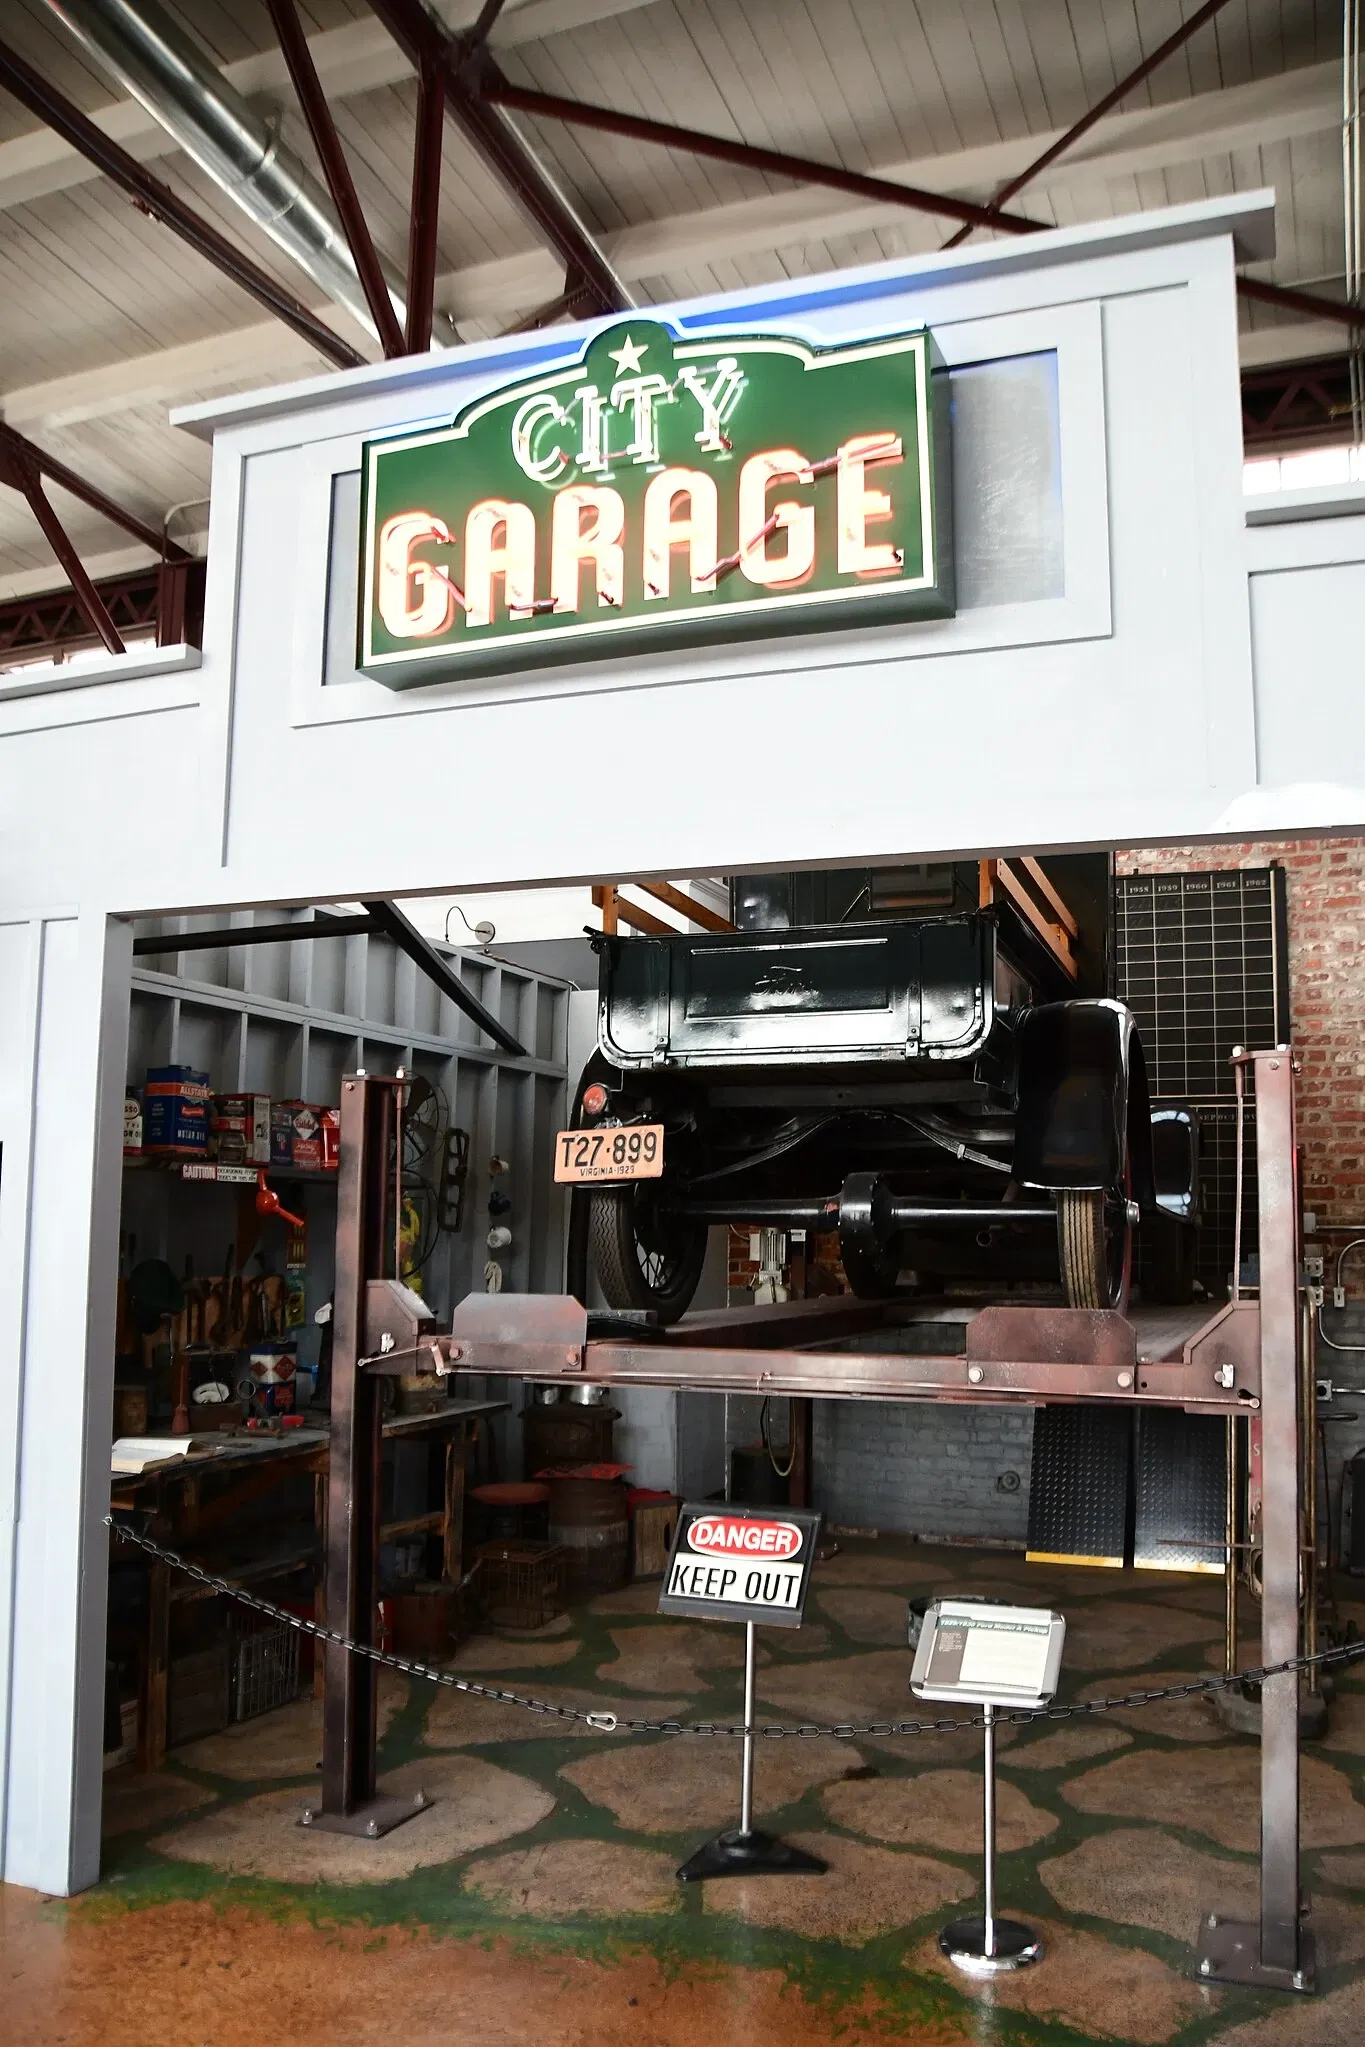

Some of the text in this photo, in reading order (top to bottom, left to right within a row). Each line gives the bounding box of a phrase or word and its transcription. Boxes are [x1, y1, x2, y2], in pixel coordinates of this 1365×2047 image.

[511, 357, 748, 488] CITY
[378, 432, 904, 638] GARAGE
[1186, 883, 1208, 891] 1960
[1216, 881, 1236, 889] 1961
[1245, 879, 1267, 887] 1962
[182, 1164, 217, 1180] CAUTION
[695, 1523, 793, 1552] DANGER
[670, 1564, 799, 1604] KEEP OUT
[1023, 1625, 1049, 1634] Pickup
